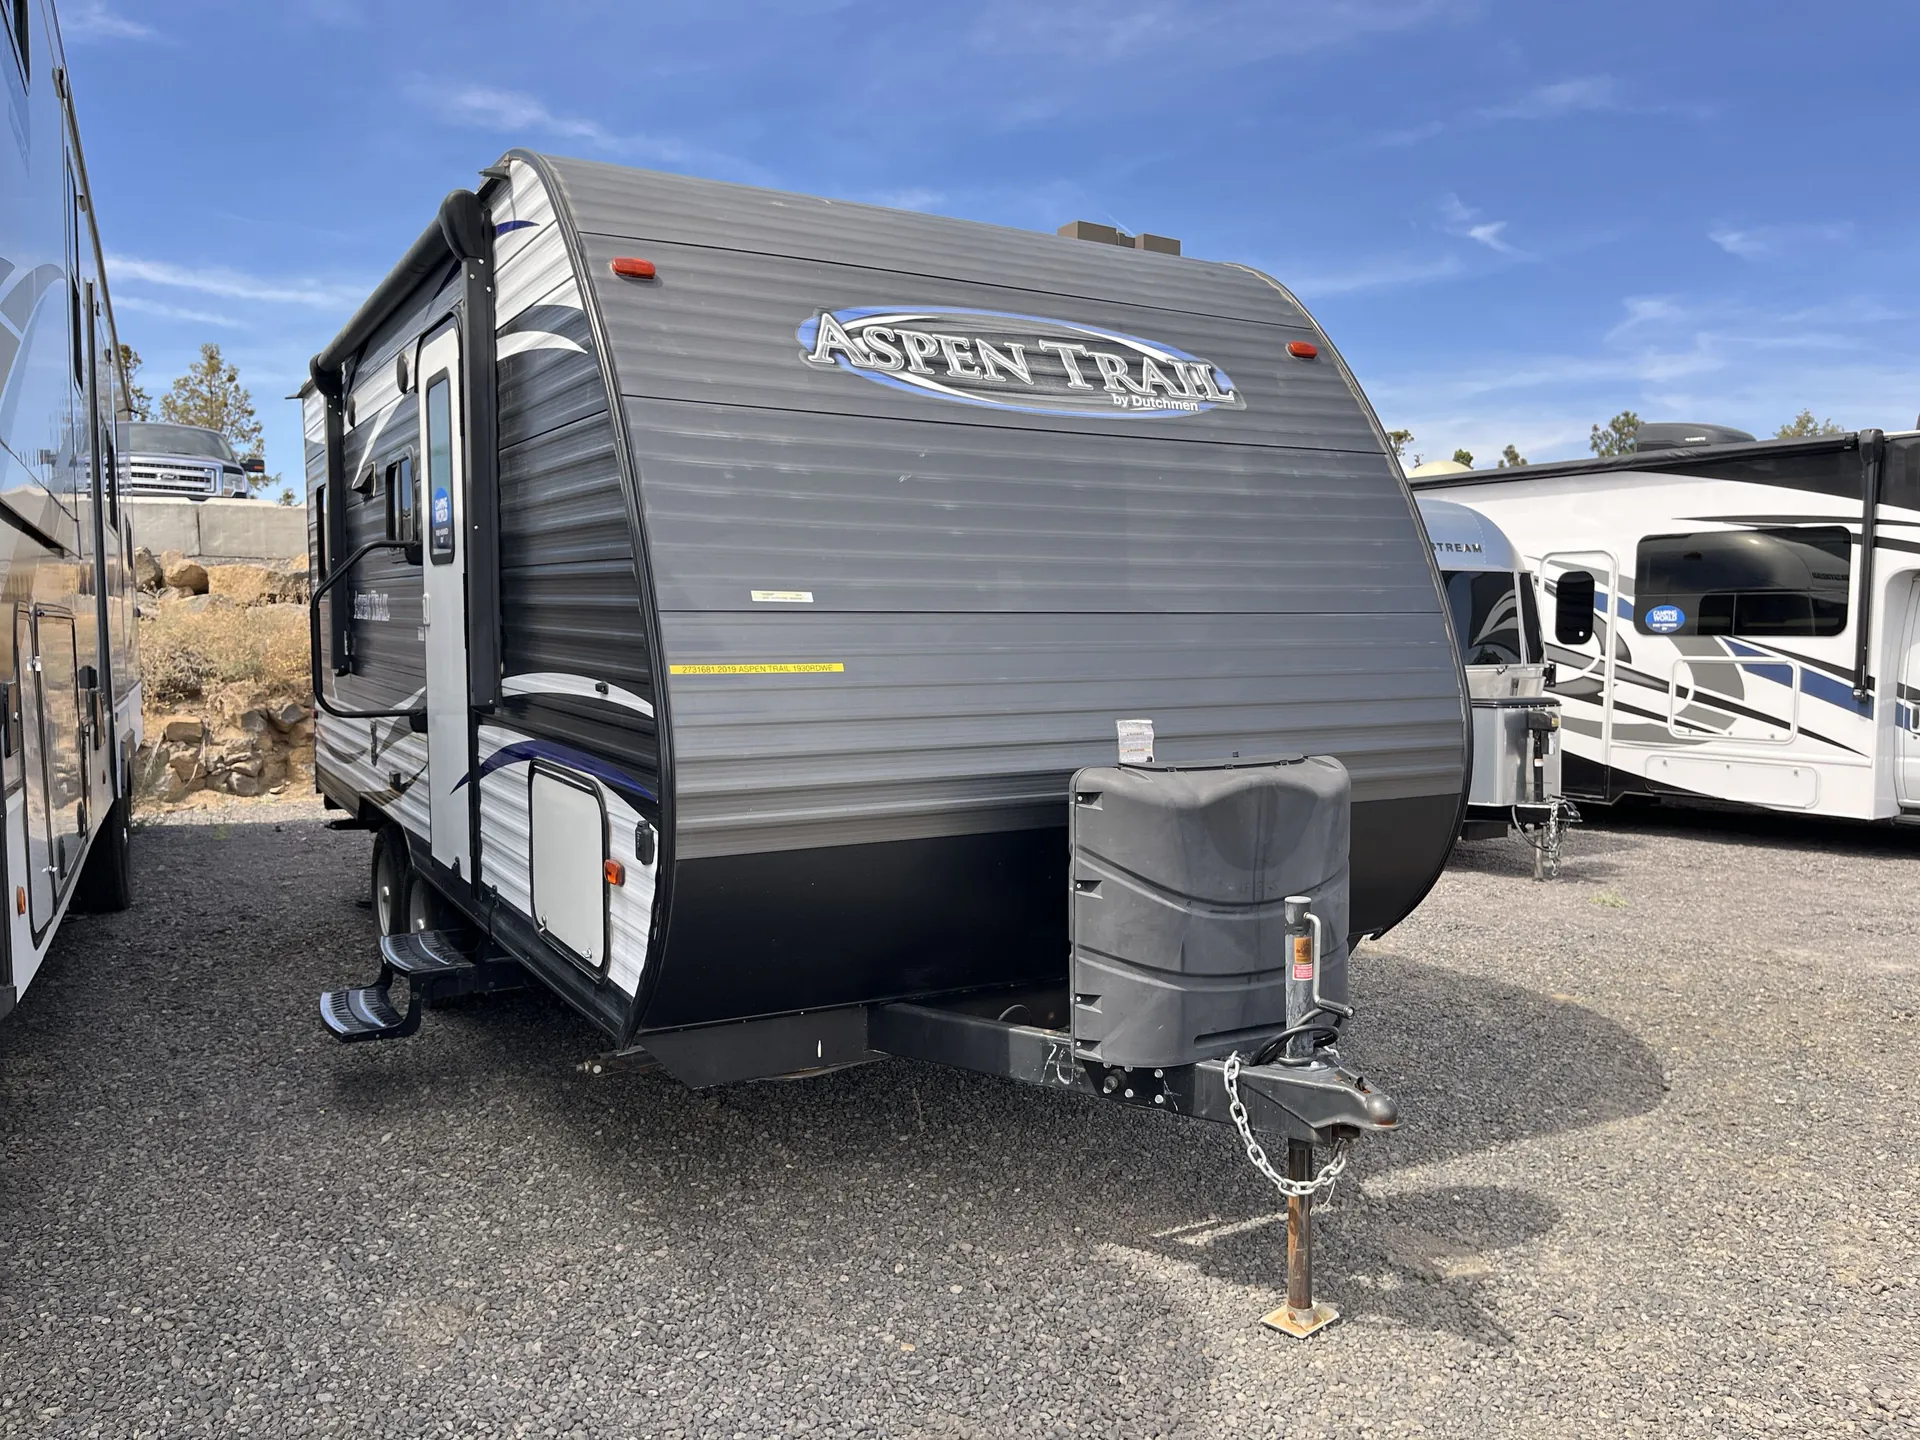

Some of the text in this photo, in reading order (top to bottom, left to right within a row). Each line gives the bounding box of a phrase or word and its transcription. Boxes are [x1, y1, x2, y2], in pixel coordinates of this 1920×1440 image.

[808, 311, 1236, 403] ASPEN TRAIL
[1112, 393, 1199, 412] by Dutchmen
[682, 665, 715, 674] 2731681
[717, 665, 737, 673] 2019
[738, 665, 766, 673] ASPEN
[768, 665, 791, 673] TRAIL
